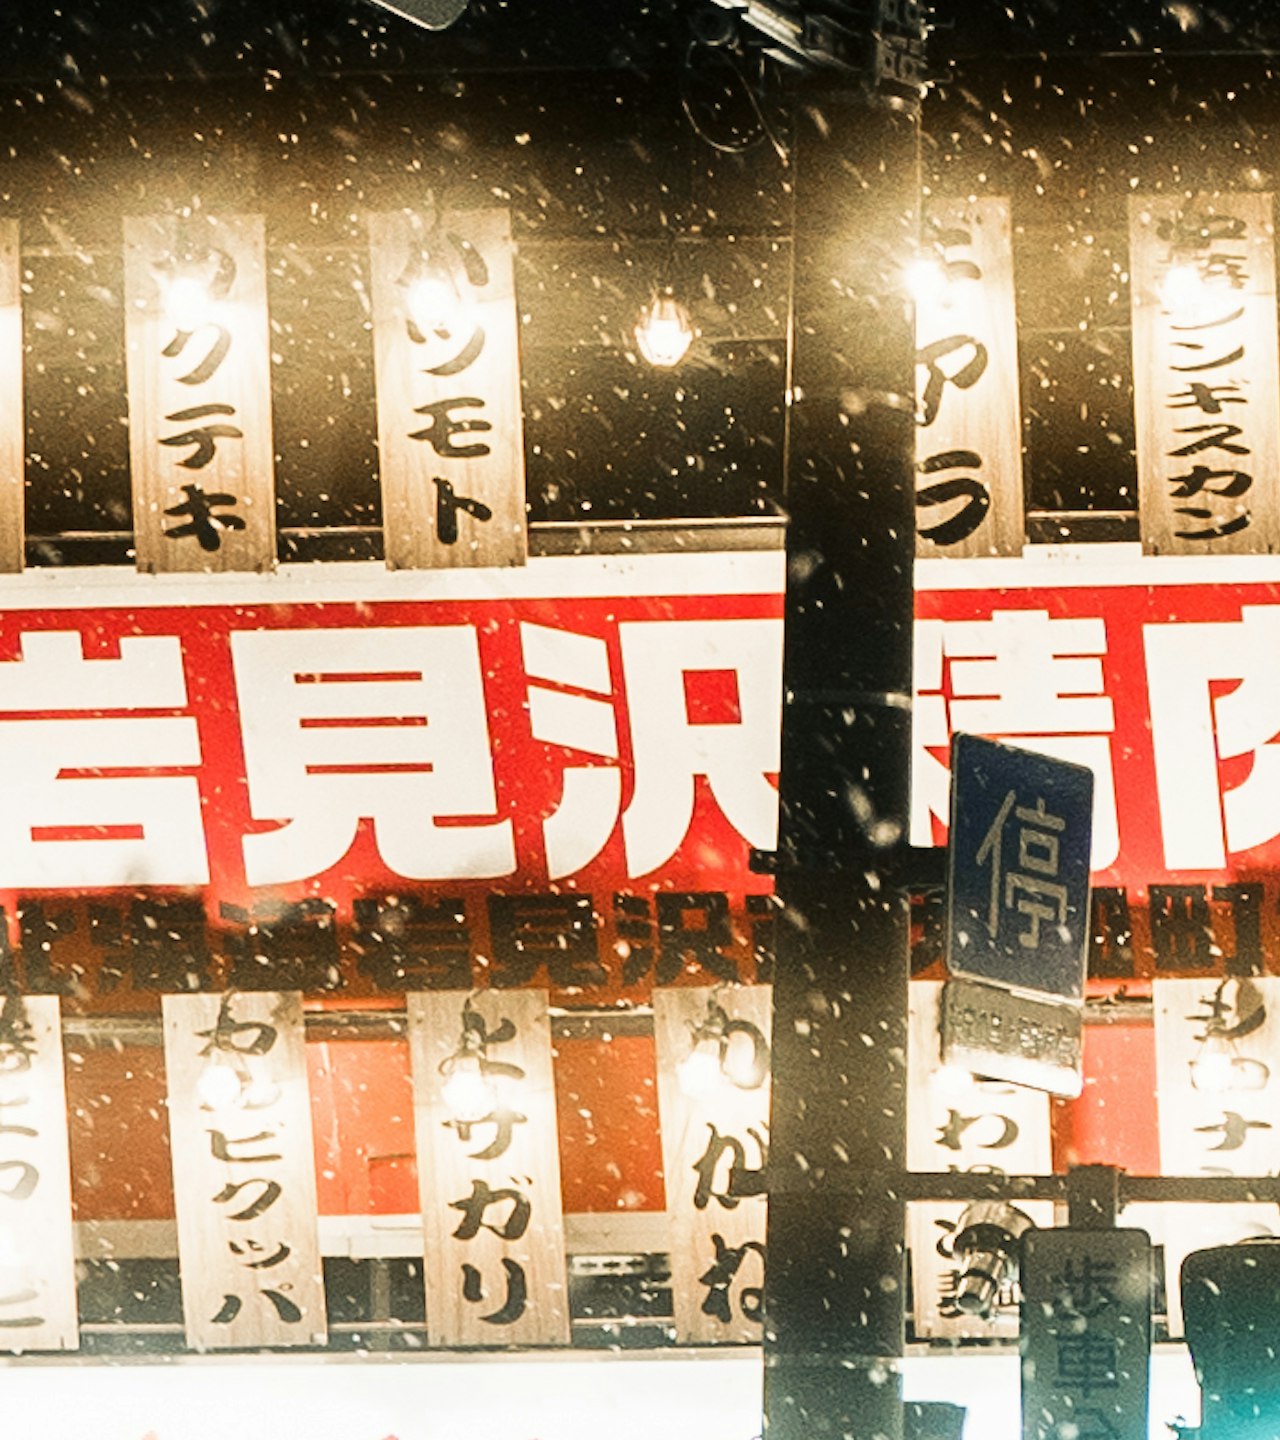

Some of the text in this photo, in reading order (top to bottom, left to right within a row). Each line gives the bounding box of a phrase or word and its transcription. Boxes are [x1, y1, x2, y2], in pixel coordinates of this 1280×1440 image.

[196, 1005, 303, 1325] カビクッパ
